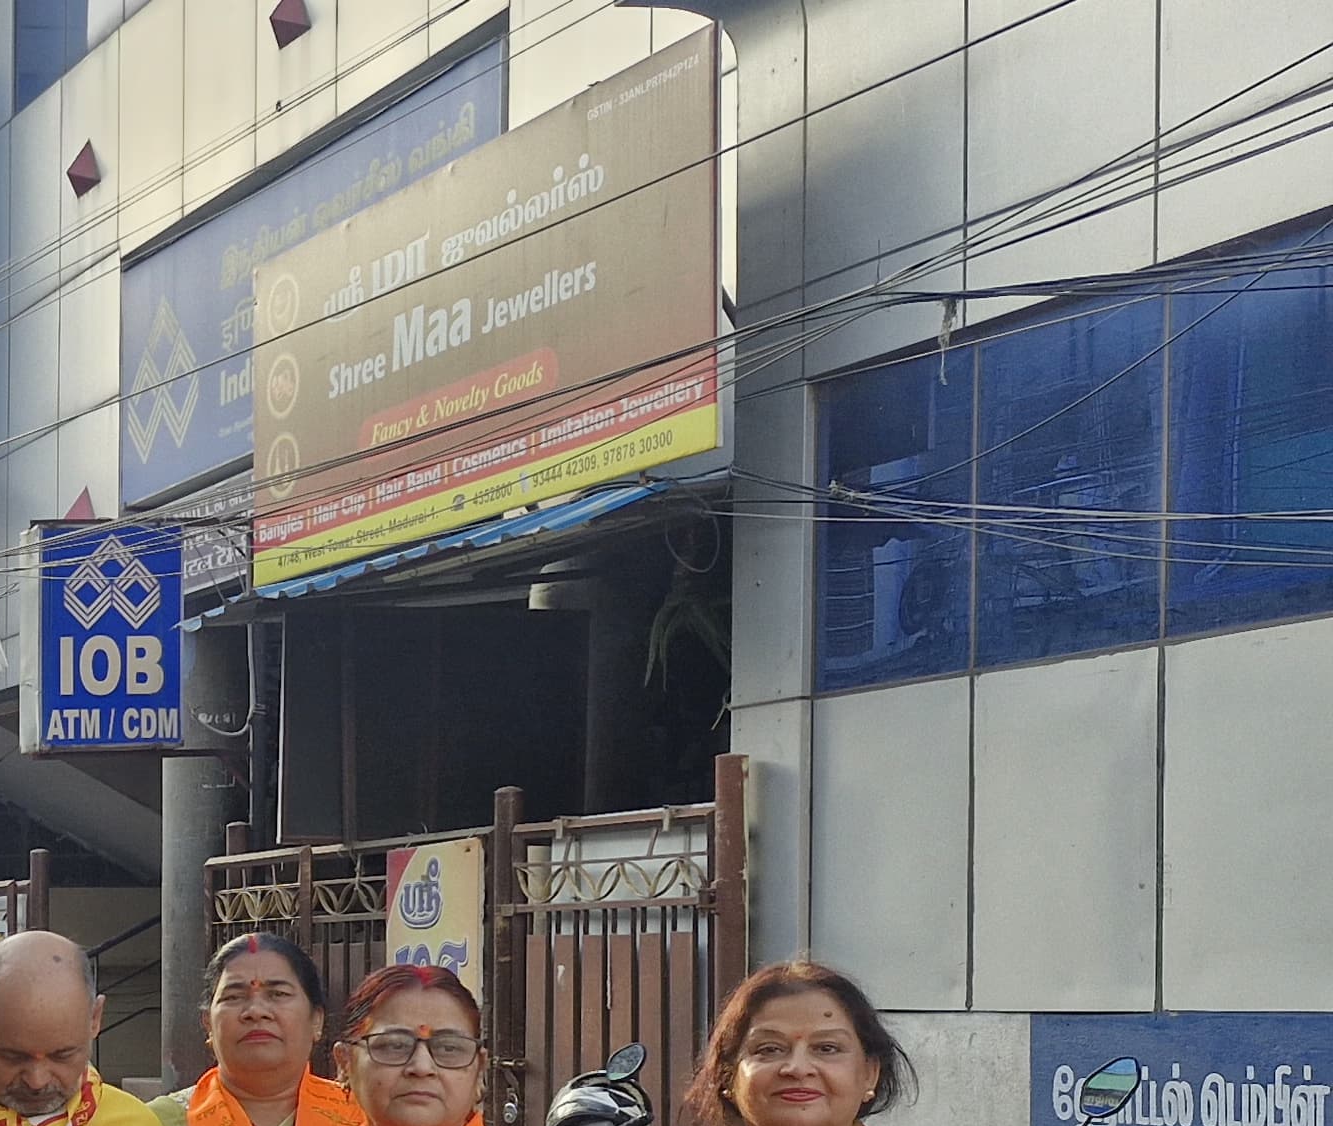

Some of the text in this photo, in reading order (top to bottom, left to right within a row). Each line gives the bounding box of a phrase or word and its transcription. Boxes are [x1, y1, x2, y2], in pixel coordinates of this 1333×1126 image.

[329, 261, 596, 399] Shree Maa Jewellers
[370, 360, 543, 446] Fancy & Novelty Goods
[259, 513, 304, 543] Bangles
[341, 491, 366, 515] Clip
[407, 465, 441, 492] Band
[452, 435, 527, 478] Cosmetics
[539, 406, 615, 449] Imitation
[619, 375, 705, 422] Jewellery
[533, 465, 563, 488] 93444
[603, 443, 635, 466] 97878
[640, 430, 673, 453] 30300
[59, 635, 164, 696] IOB
[47, 708, 101, 740] ATM
[122, 708, 178, 740] CDM
